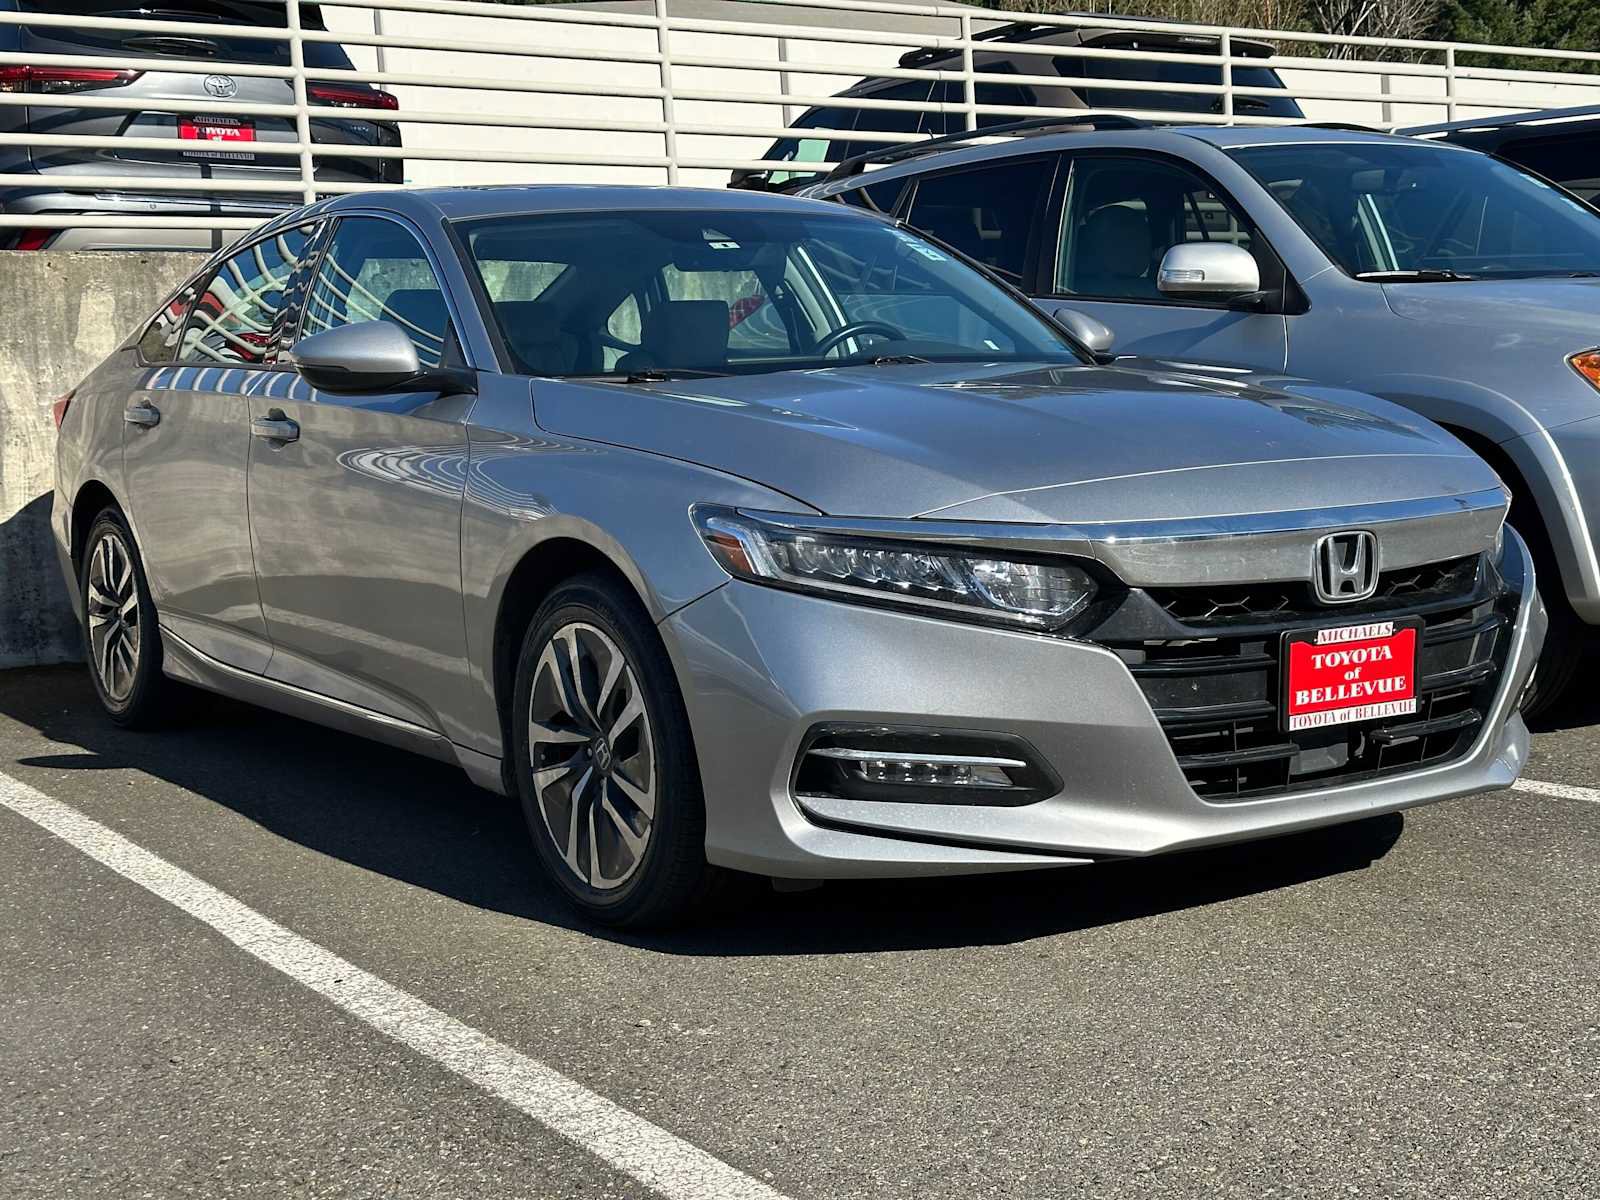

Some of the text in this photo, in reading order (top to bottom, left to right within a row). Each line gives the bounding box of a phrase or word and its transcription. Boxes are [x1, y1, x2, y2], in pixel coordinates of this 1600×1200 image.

[1320, 624, 1392, 642] MICHAELS
[1311, 645, 1393, 670] TOYOTA
[1344, 667, 1362, 681] of
[1295, 676, 1406, 706] BELLEVUE
[1291, 711, 1337, 729] TOYOTA
[1355, 699, 1416, 719] BELLEVUE
